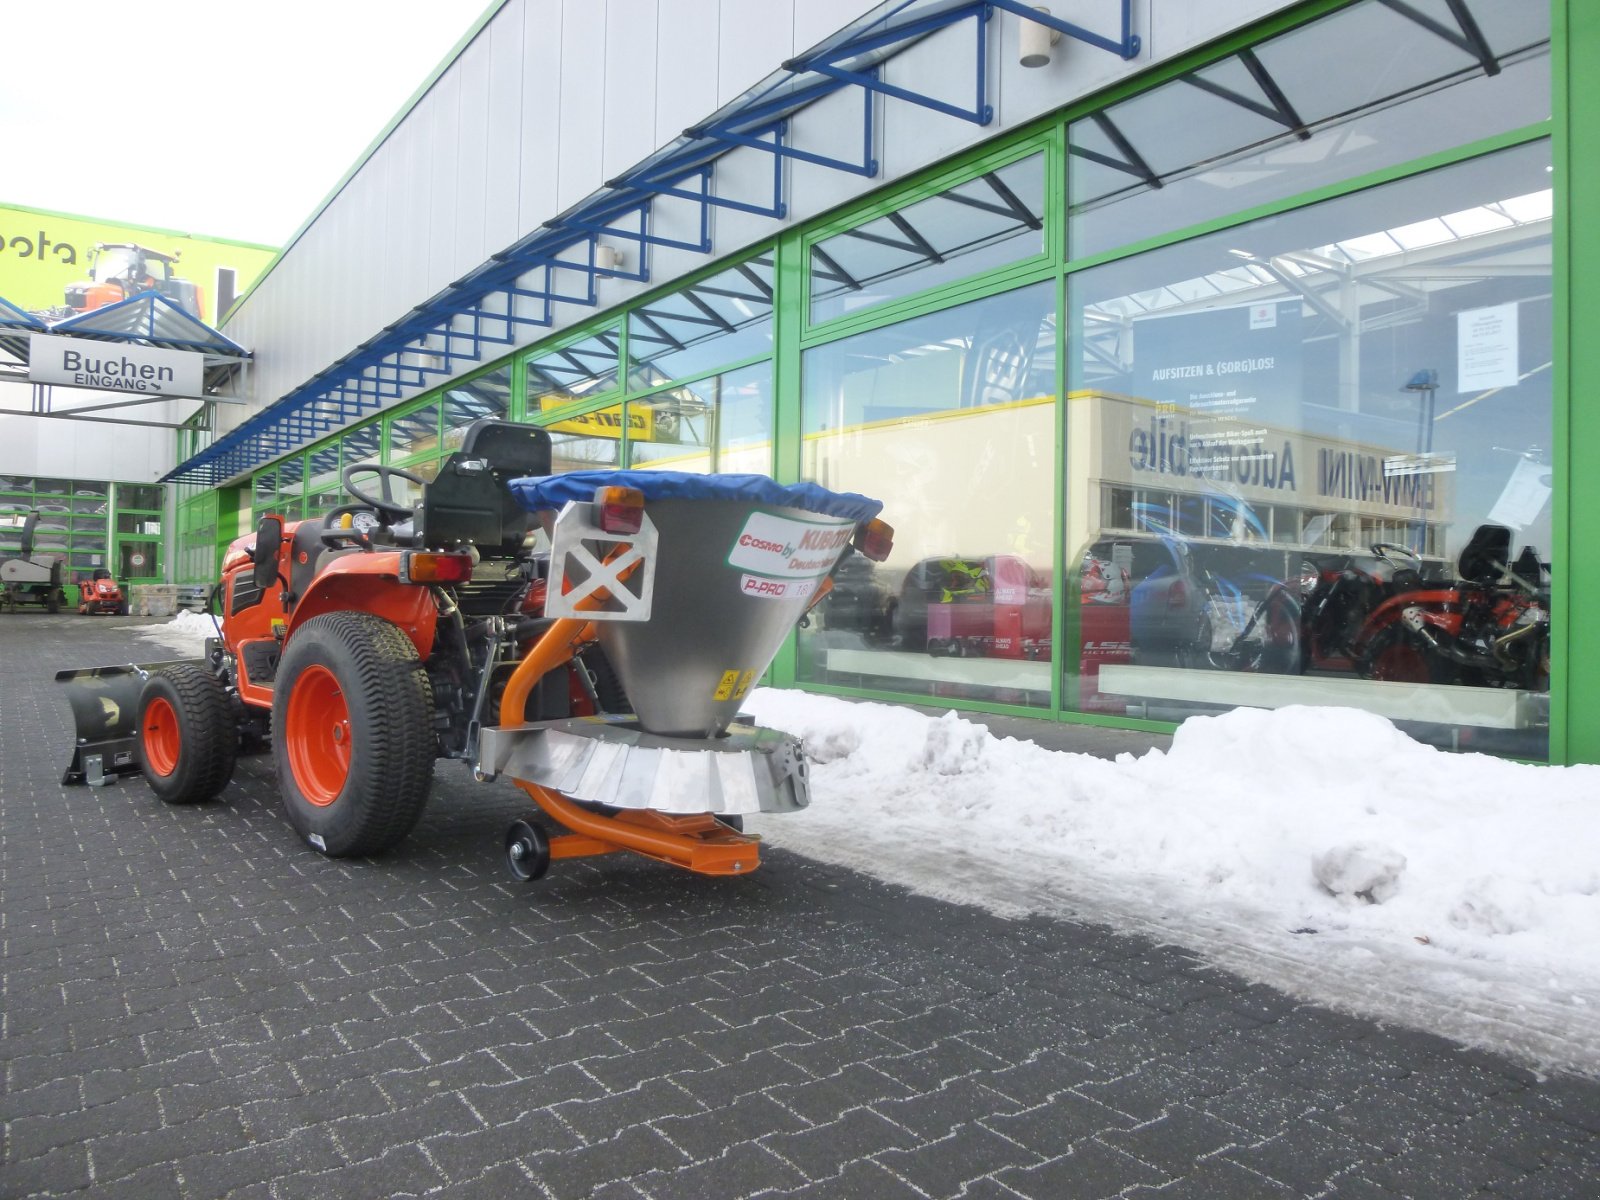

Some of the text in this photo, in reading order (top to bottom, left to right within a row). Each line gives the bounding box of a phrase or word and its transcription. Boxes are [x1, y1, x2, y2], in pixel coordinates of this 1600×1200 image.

[0, 231, 77, 265] ota
[63, 350, 174, 382] Buchen
[1152, 357, 1275, 381] AUFSITZEN & (SORG)LOS!
[74, 373, 147, 391] EINGANG
[781, 542, 796, 559] by
[744, 578, 786, 596] P-PRO
